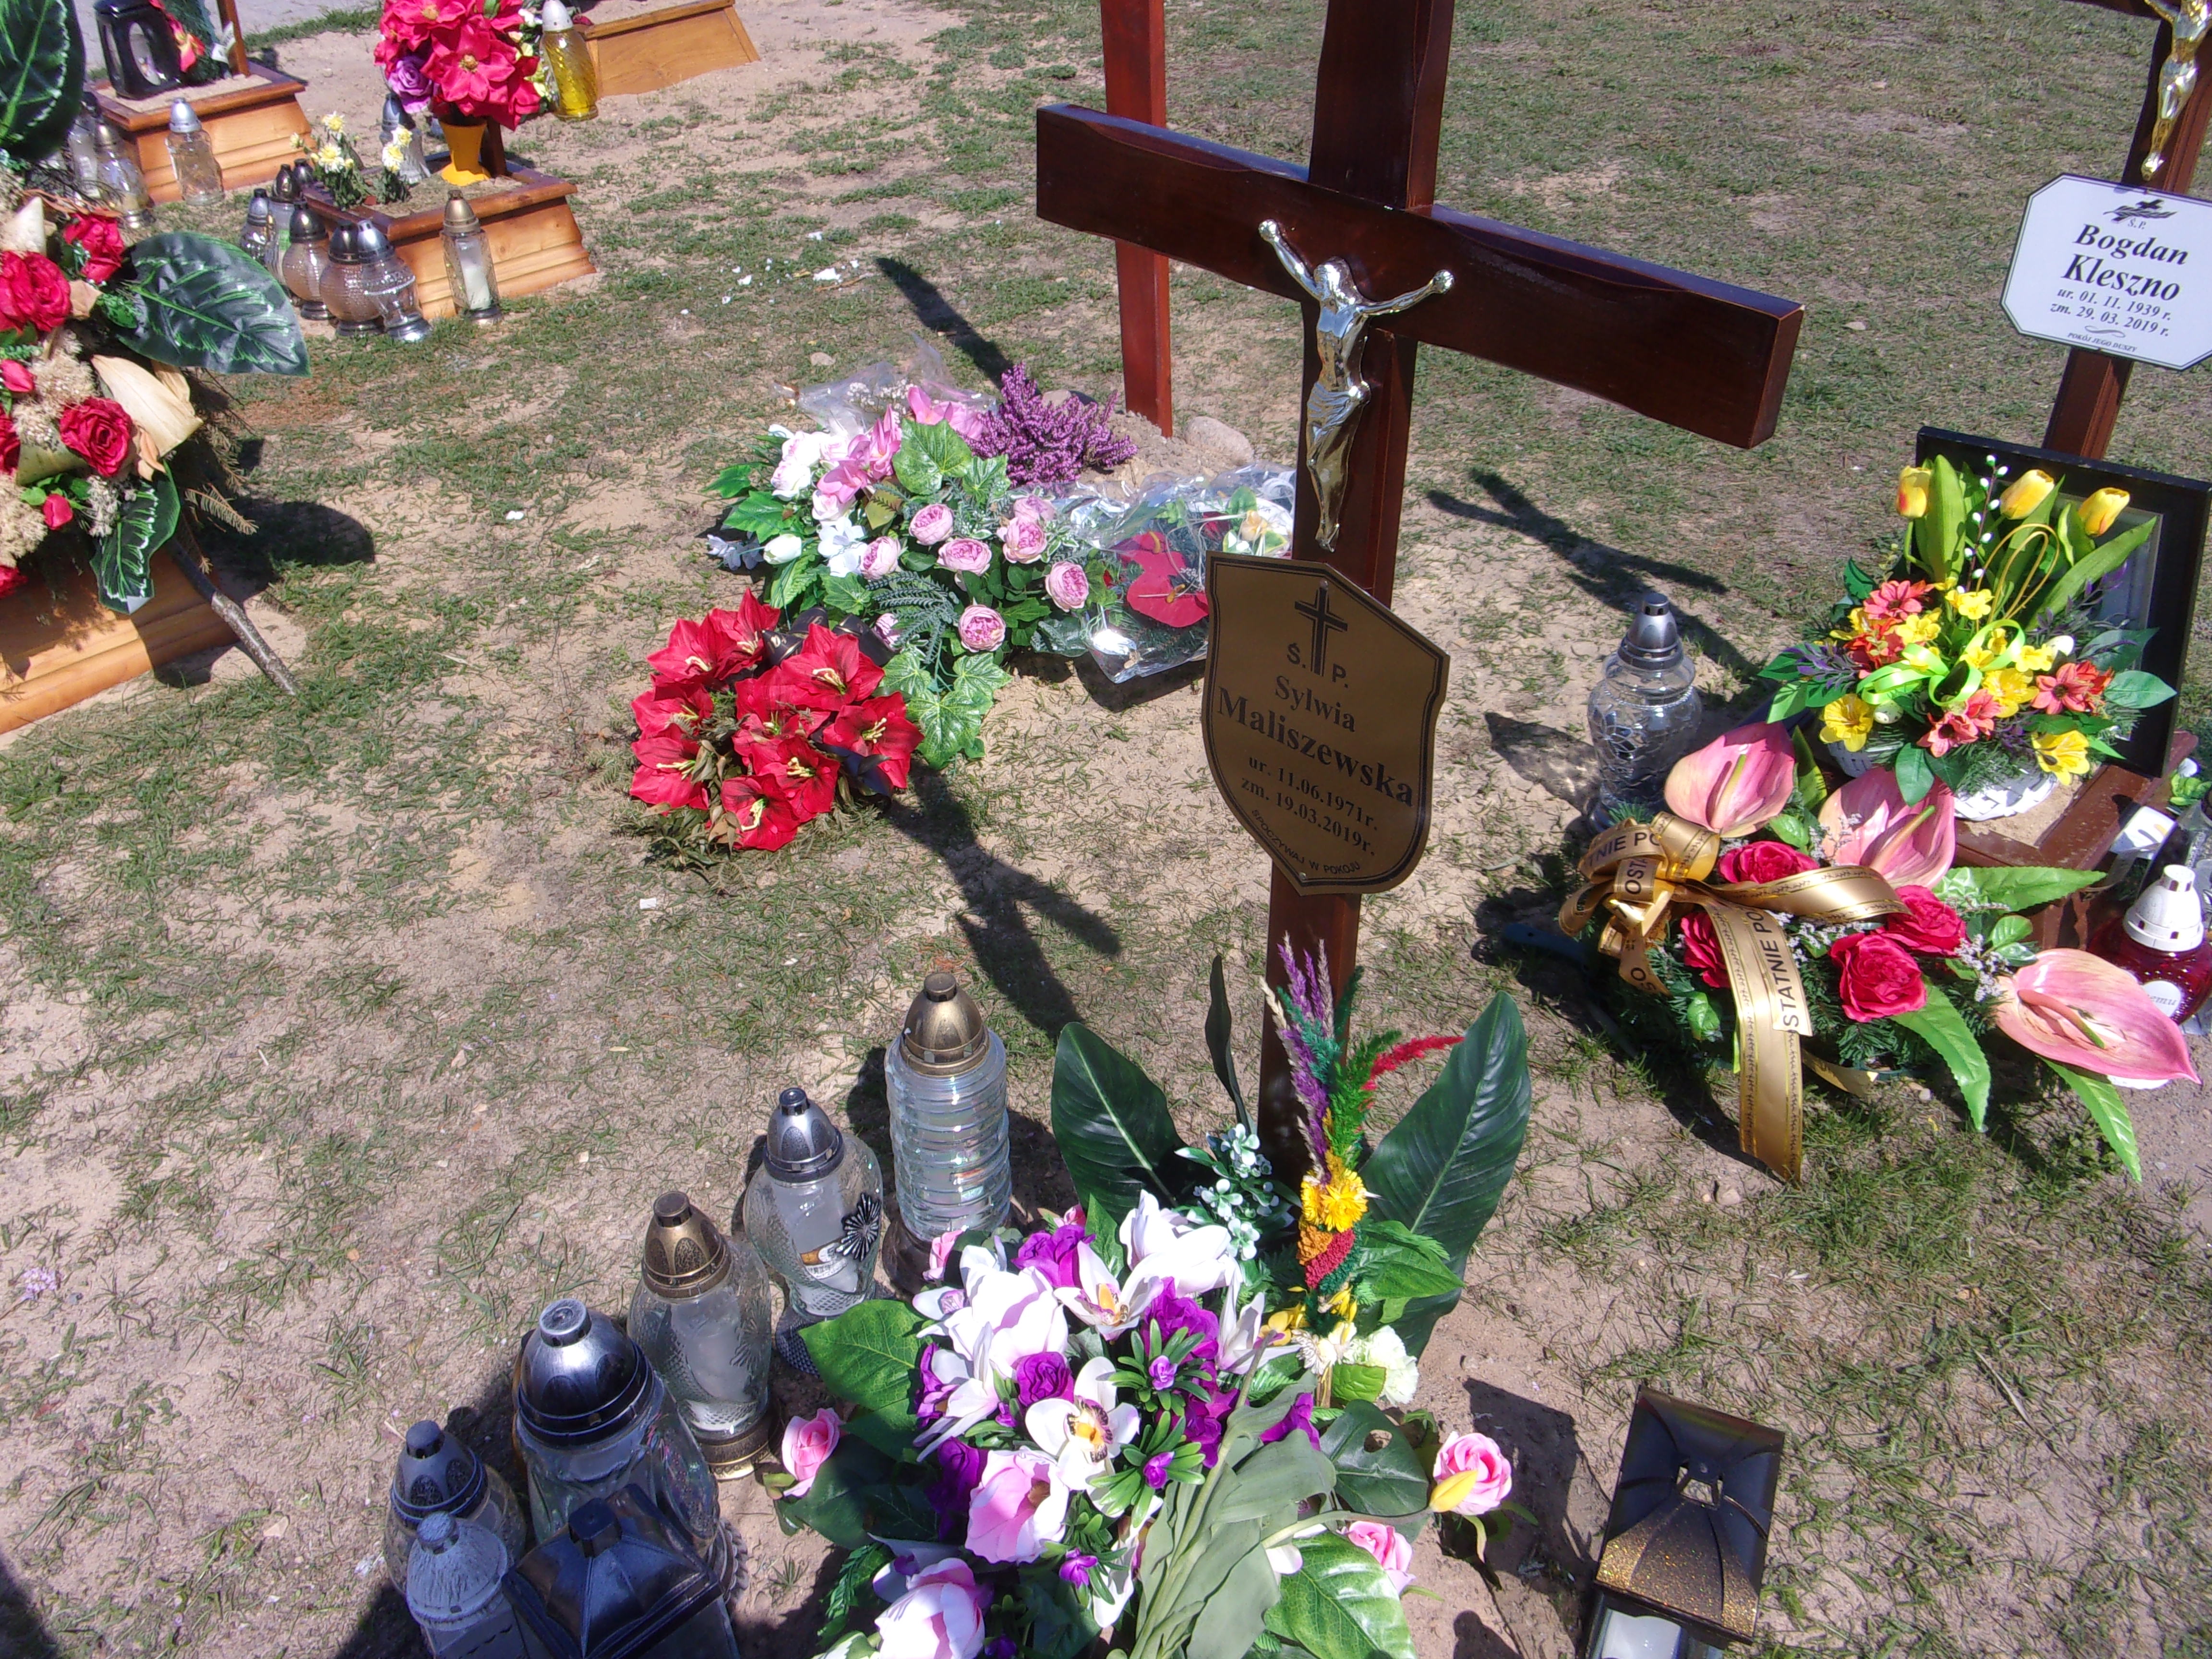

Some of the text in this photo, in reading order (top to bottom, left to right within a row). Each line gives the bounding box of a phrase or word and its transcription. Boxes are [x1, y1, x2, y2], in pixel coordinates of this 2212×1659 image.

[2072, 224, 2189, 265] Bogdan
[2060, 253, 2180, 301] Kleszno
[2050, 303, 2169, 337] zm. 29. 03. 2019 r.
[2057, 289, 2171, 321] ur. 01. 11. 1939 r.
[2068, 332, 2138, 352] POKÓJ JEGO DUSZY
[1332, 663, 1349, 688] P.
[1275, 675, 1355, 732] Sylwia
[1218, 686, 1413, 807] Maliszewska
[1241, 778, 1375, 856] zm. 19.03.2019r.
[1249, 757, 1378, 831] ur. 11.06.1971r.
[1252, 810, 1360, 874] SPOCZYWAJ W POKOJU
[1760, 939, 1799, 1033] STATNIE
